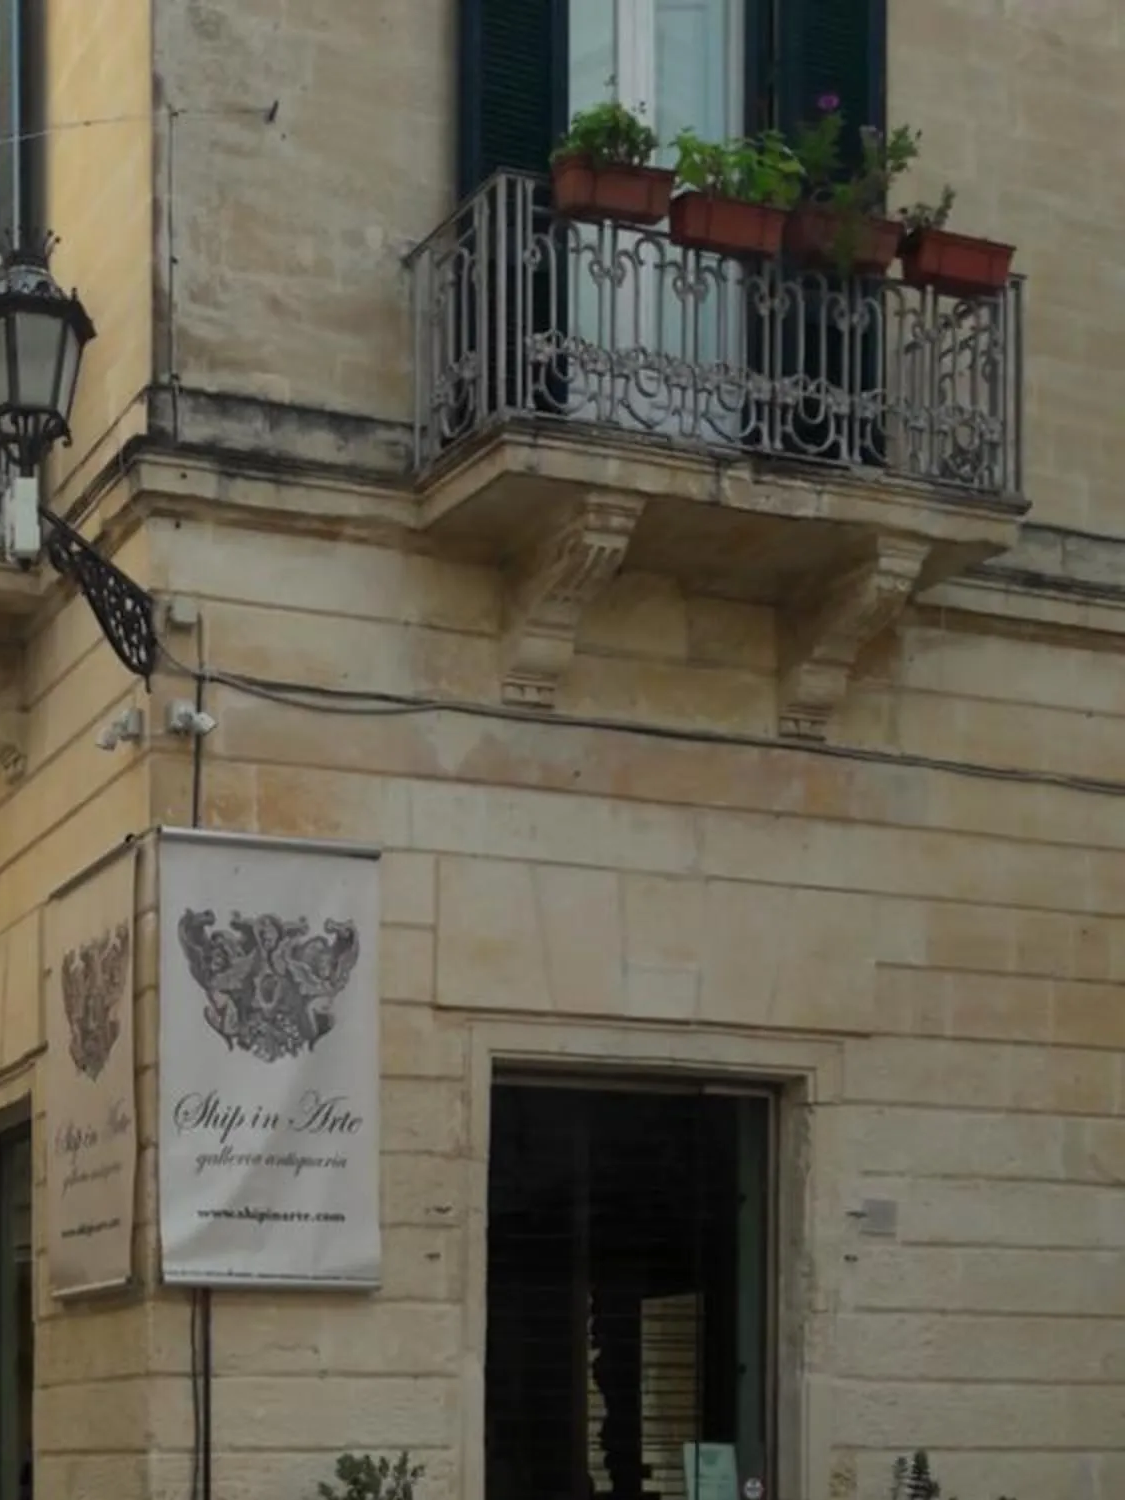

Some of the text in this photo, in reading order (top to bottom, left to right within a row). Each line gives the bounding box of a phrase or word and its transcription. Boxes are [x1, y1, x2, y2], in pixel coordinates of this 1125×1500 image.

[174, 1090, 365, 1144] Ship in Arte
